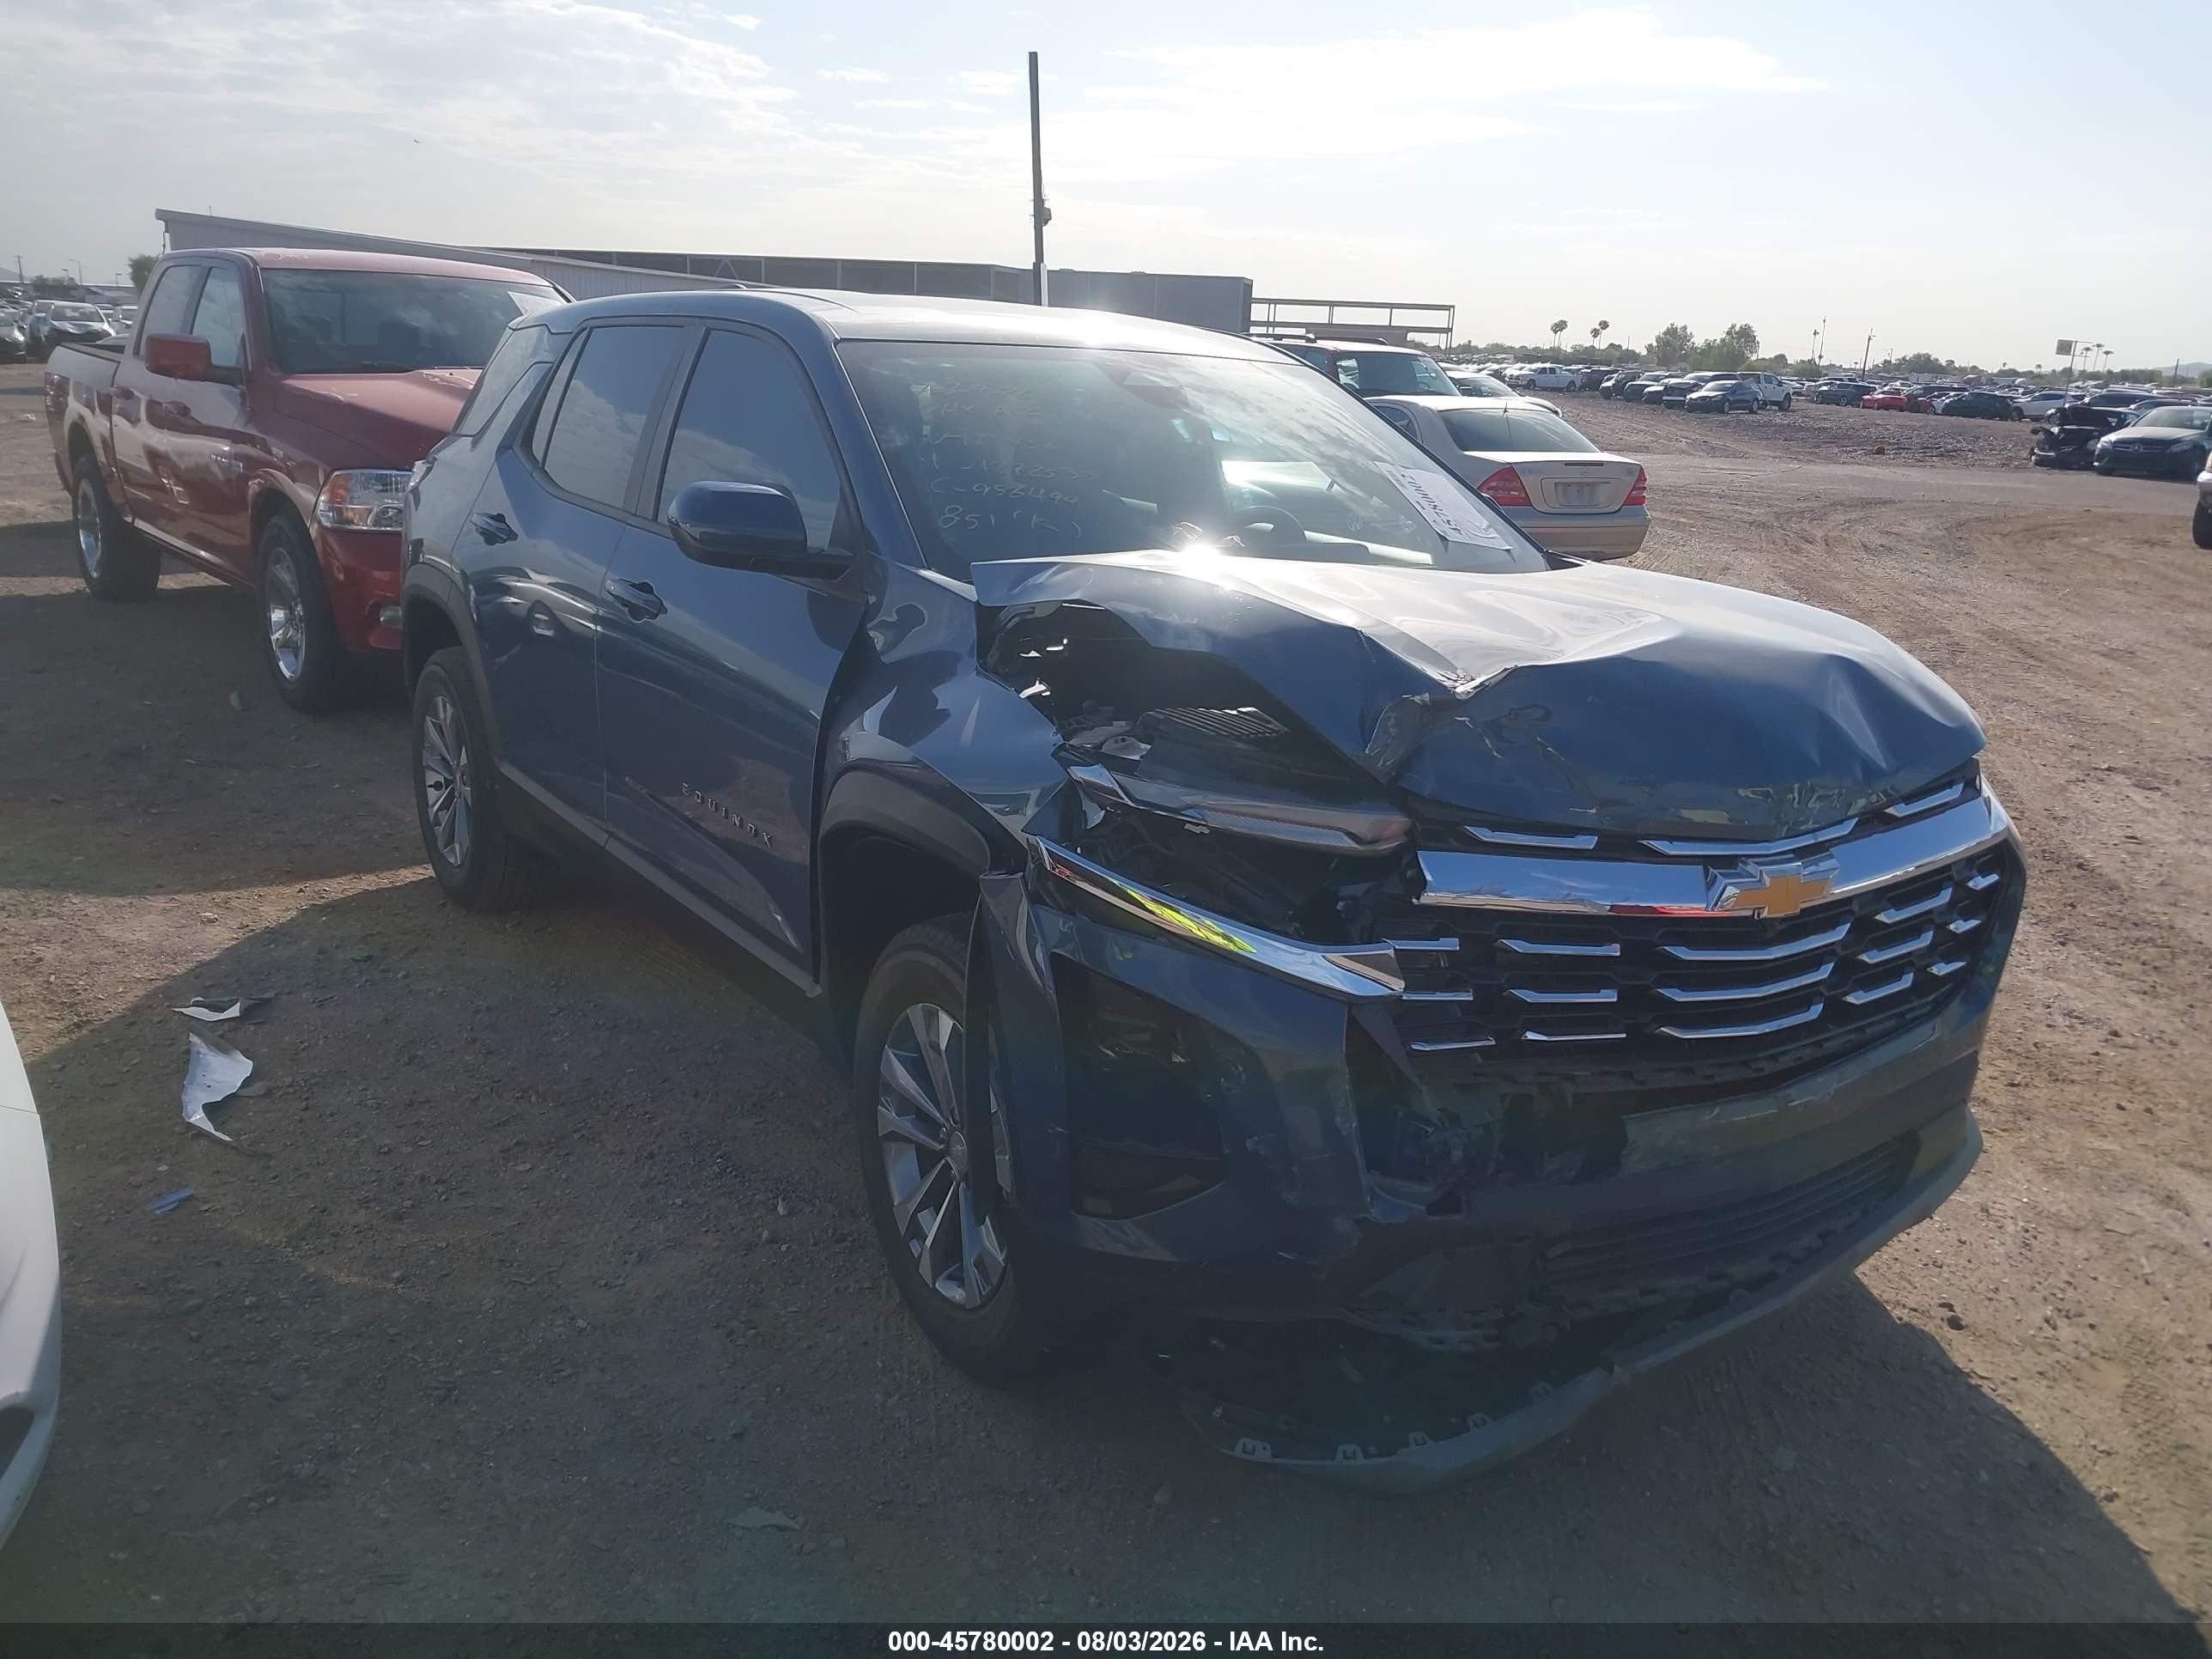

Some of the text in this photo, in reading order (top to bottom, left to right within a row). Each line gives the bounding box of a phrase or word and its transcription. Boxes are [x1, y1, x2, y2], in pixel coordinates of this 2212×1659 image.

[939, 505, 995, 529] 851
[1401, 473, 1462, 535] 45780002
[682, 782, 772, 849] EQUINOX
